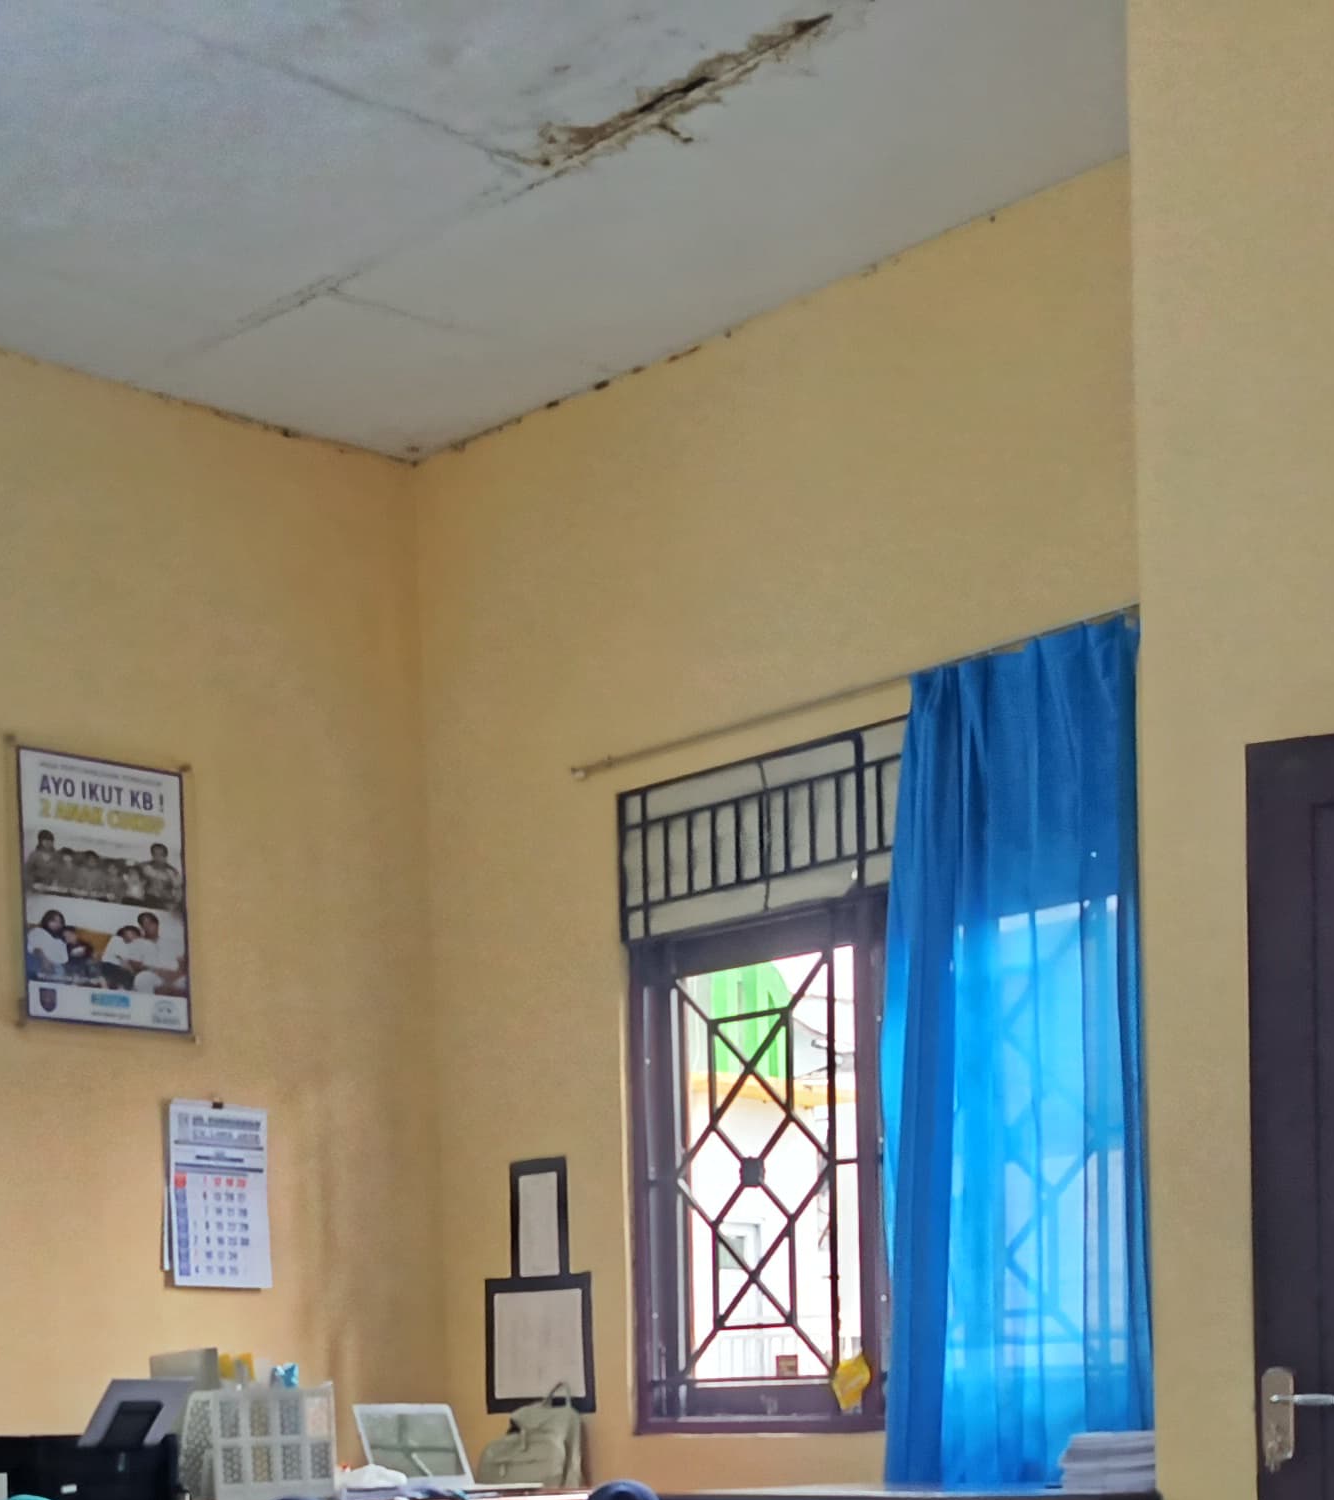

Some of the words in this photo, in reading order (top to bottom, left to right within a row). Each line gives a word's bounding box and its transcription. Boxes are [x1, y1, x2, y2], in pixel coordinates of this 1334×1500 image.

[39, 774, 75, 797] AYO
[81, 780, 124, 806] IKUT
[130, 790, 154, 811] KB
